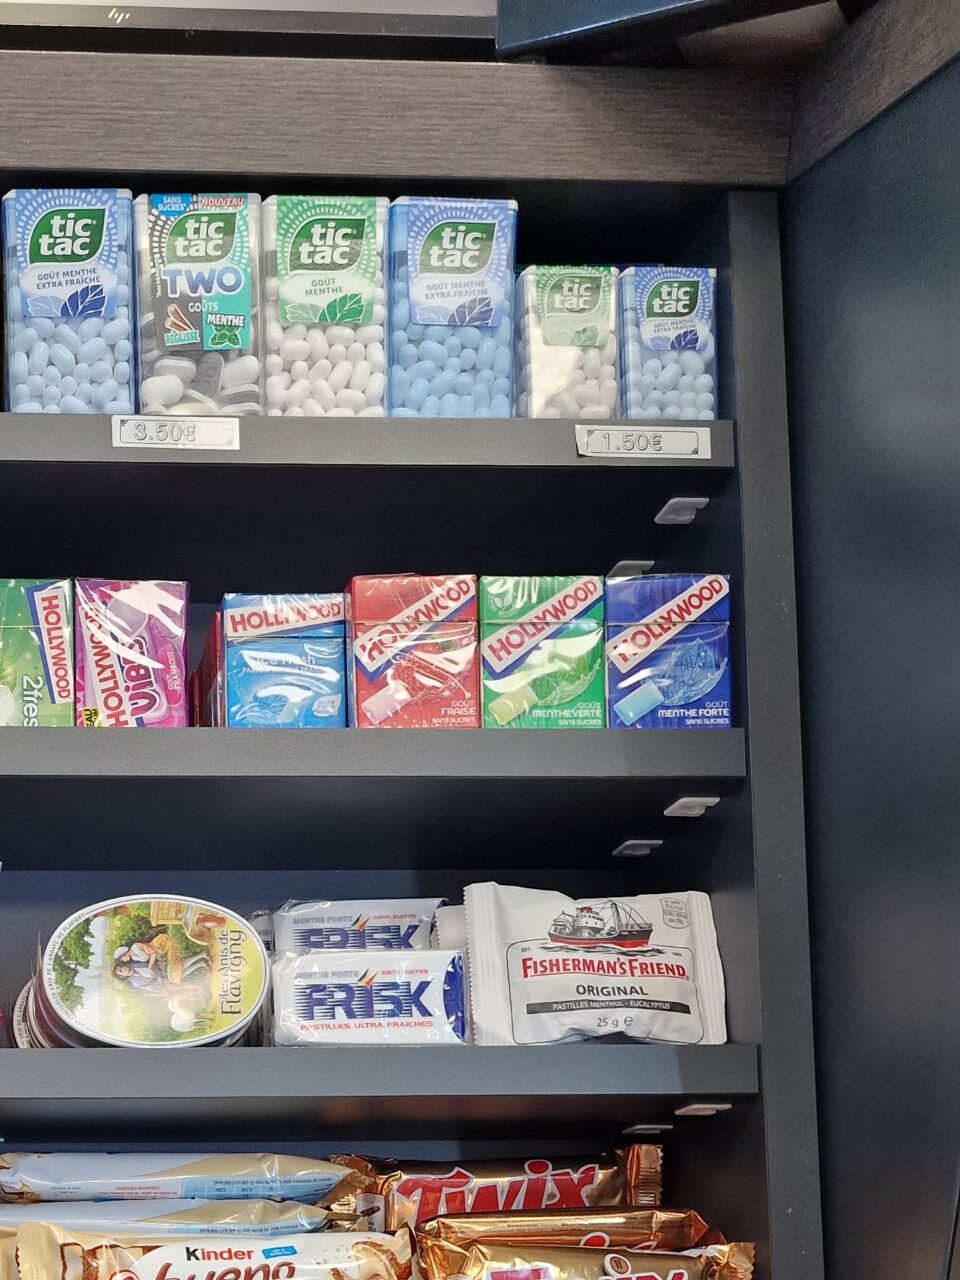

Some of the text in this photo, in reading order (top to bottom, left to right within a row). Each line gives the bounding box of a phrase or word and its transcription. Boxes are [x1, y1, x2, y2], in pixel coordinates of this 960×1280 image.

[201, 197, 244, 206] NOUVEAU
[51, 214, 92, 237] tic
[185, 217, 224, 239] tic
[311, 223, 353, 246] tic
[441, 226, 483, 250] tic
[39, 234, 90, 256] tac
[175, 237, 222, 257] tac
[298, 243, 349, 265] tac
[429, 246, 479, 268] tac
[36, 274, 102, 290] EXTRA FRAÎCHE
[37, 267, 98, 281] GOÛT MENTHE
[162, 266, 243, 297] TWO
[311, 277, 335, 287] GOÛT
[305, 285, 344, 295] MENTHE
[425, 286, 489, 300] EXTRA FRAÎCHE
[426, 280, 486, 292] GOÛT MENTHE
[561, 279, 592, 296] tic
[660, 284, 692, 300] tic
[188, 300, 219, 312] GOÛTS
[553, 294, 591, 309] tac
[653, 298, 690, 313] tac
[207, 314, 245, 326] MENTHE
[165, 330, 200, 344] RÉGLISSE
[133, 423, 197, 443] 3.50€
[601, 432, 663, 451] 1.50€
[230, 602, 341, 633] HOLLWOOD
[359, 579, 471, 662] HOLLYWOOD
[488, 579, 598, 663] HOLLYWOOD
[41, 594, 71, 699] HOLLYWOOD
[84, 610, 129, 727] HOLLYWO
[441, 707, 476, 715] FRAISE
[705, 700, 728, 708] GOÛT
[532, 709, 602, 718] MENTHE VERTE
[658, 708, 730, 717] MENTHE FORTE
[294, 924, 420, 949] FRISK
[217, 930, 229, 979] Anis de
[220, 930, 248, 1016] Flavigny
[331, 970, 359, 979] FORTE
[522, 956, 687, 979] FISHERMAN'S FRIEND
[575, 984, 649, 996] ORIGINAL
[294, 980, 433, 1020] FRISK
[552, 1001, 671, 1011] PASTILLES MENTHOL EUCALYPTUS
[300, 1020, 433, 1031] PASTILLES ULTRA FRAICHES
[597, 1017, 619, 1029] 25 g
[185, 1246, 254, 1262] Kinder
